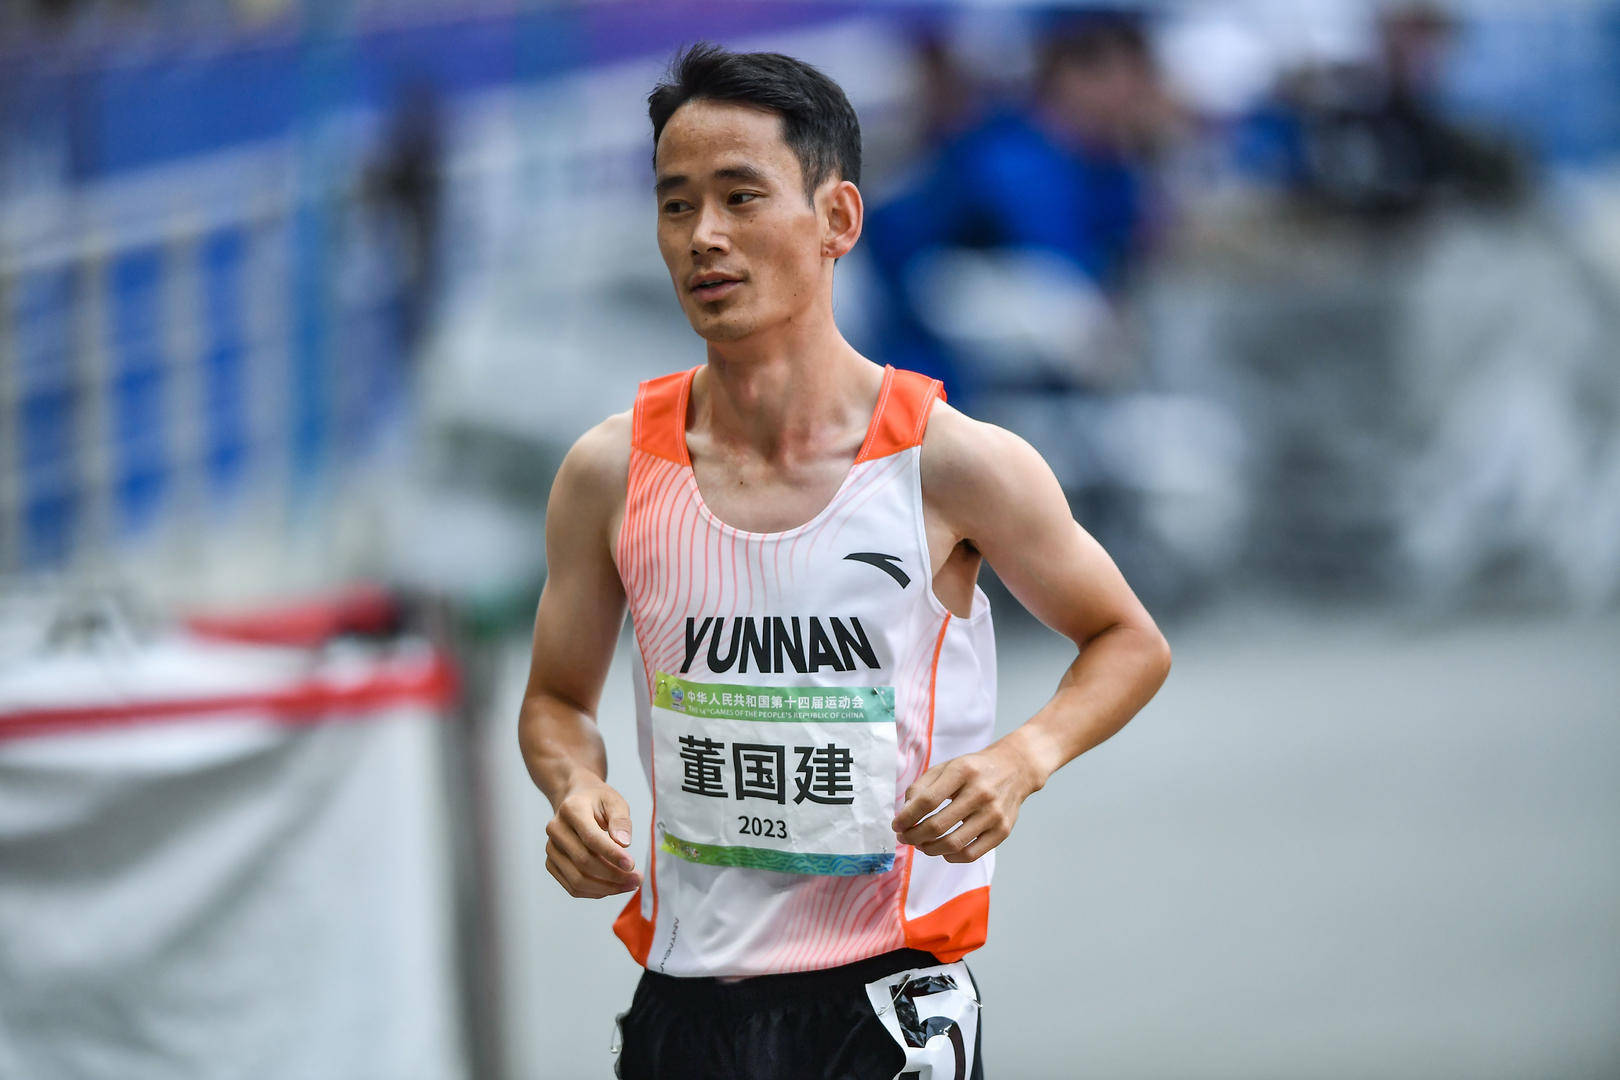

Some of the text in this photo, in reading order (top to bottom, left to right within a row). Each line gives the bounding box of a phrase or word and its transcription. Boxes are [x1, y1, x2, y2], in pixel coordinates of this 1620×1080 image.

[680, 616, 881, 674] YUNNAN
[687, 690, 864, 710] 中华人民共和国第十四届运动会
[711, 709, 734, 717] GAMES
[758, 711, 792, 719] PEOPLE'S
[679, 735, 854, 805] 董国建
[738, 816, 788, 839] 2023
